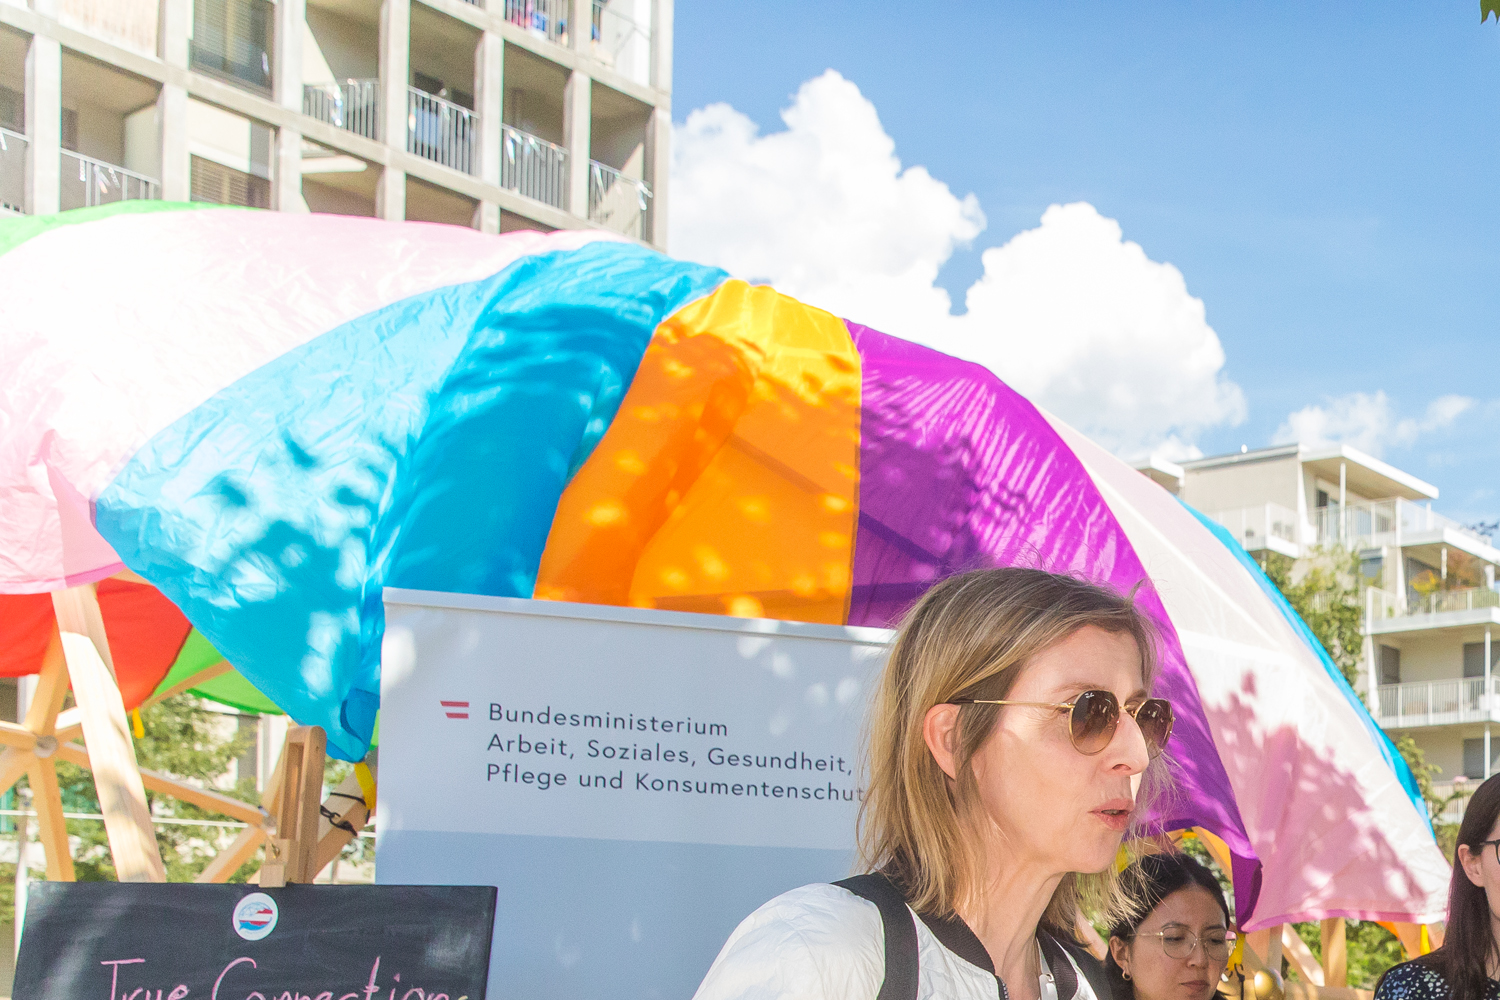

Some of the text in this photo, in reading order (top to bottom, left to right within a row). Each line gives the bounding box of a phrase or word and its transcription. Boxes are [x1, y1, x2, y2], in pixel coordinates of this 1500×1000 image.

[489, 702, 729, 738] Bundesministerium
[487, 734, 853, 777] Arbeit, Soziales, Gesundheit,
[487, 763, 567, 790] Pflege
[579, 771, 623, 790] und
